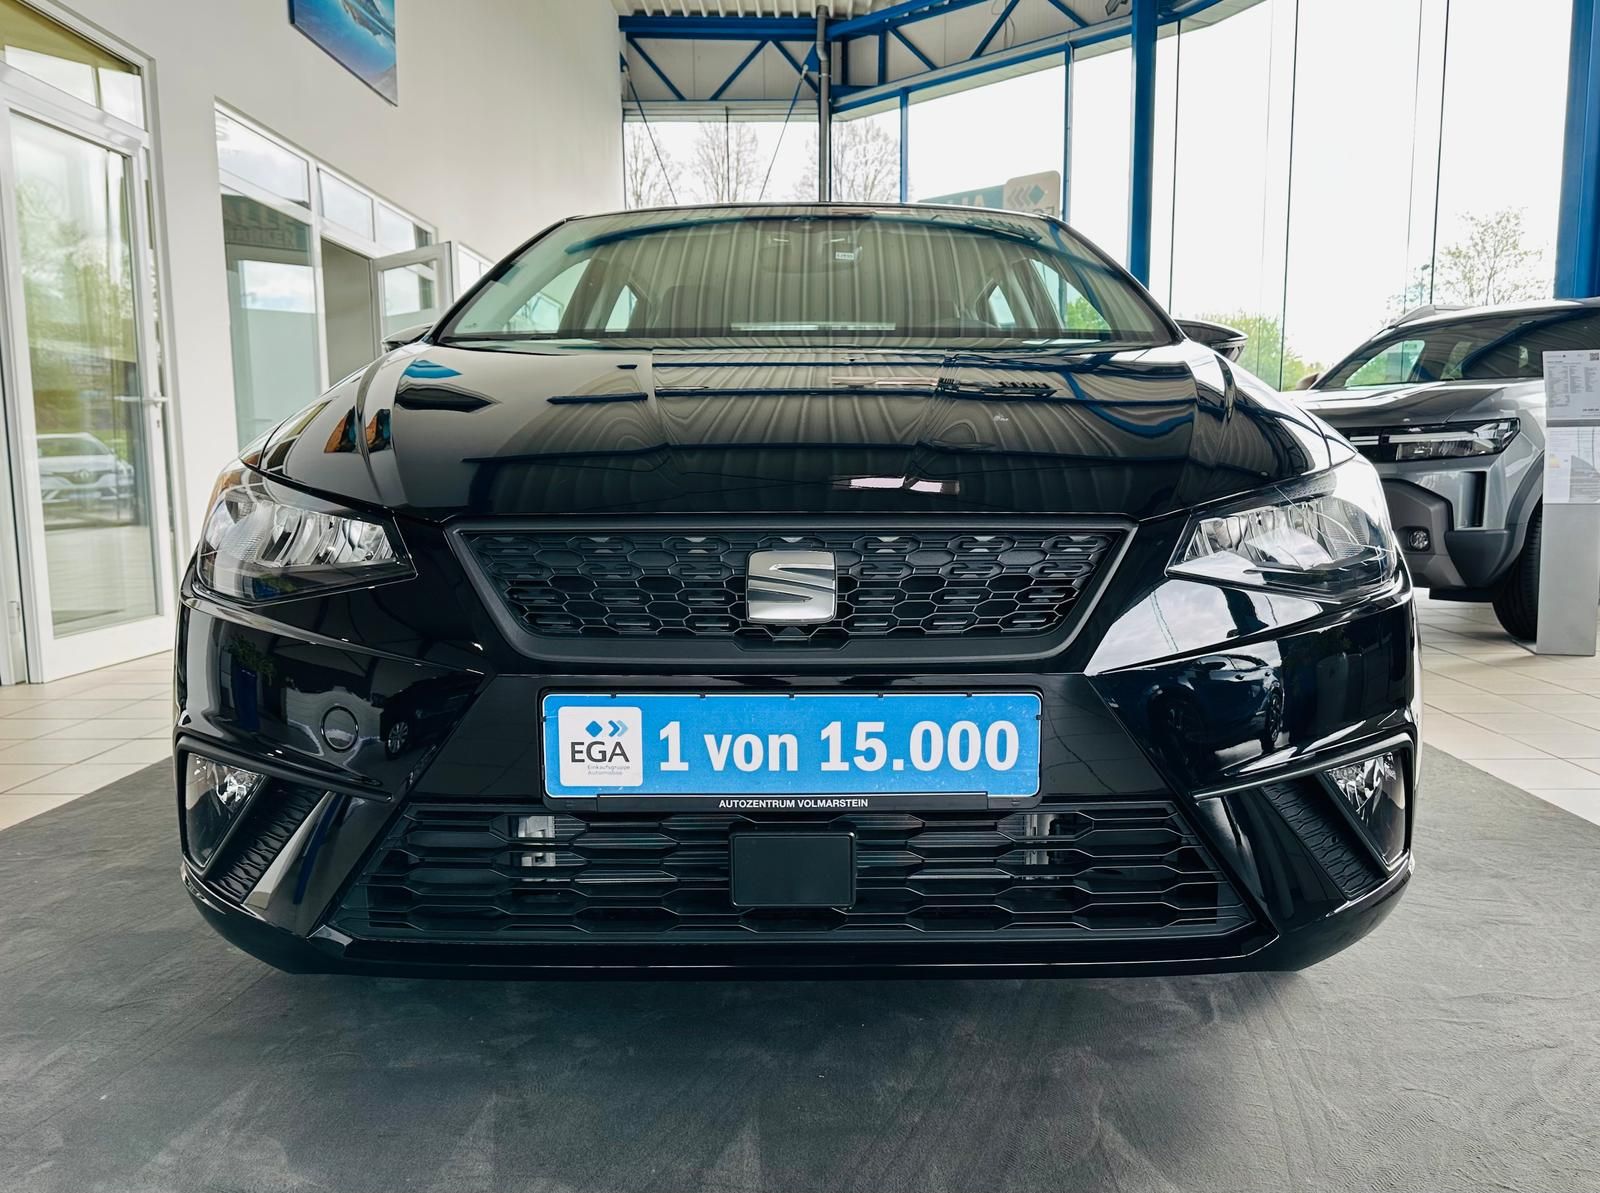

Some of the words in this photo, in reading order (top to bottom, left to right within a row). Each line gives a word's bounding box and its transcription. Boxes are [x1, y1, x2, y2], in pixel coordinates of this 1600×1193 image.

[570, 740, 630, 763] EGA
[660, 721, 688, 771] 1
[704, 733, 797, 772] von
[821, 720, 1019, 771] 15.000
[719, 799, 795, 808] AUTOZENTRUM
[798, 798, 868, 808] VOLMARSTEIN
